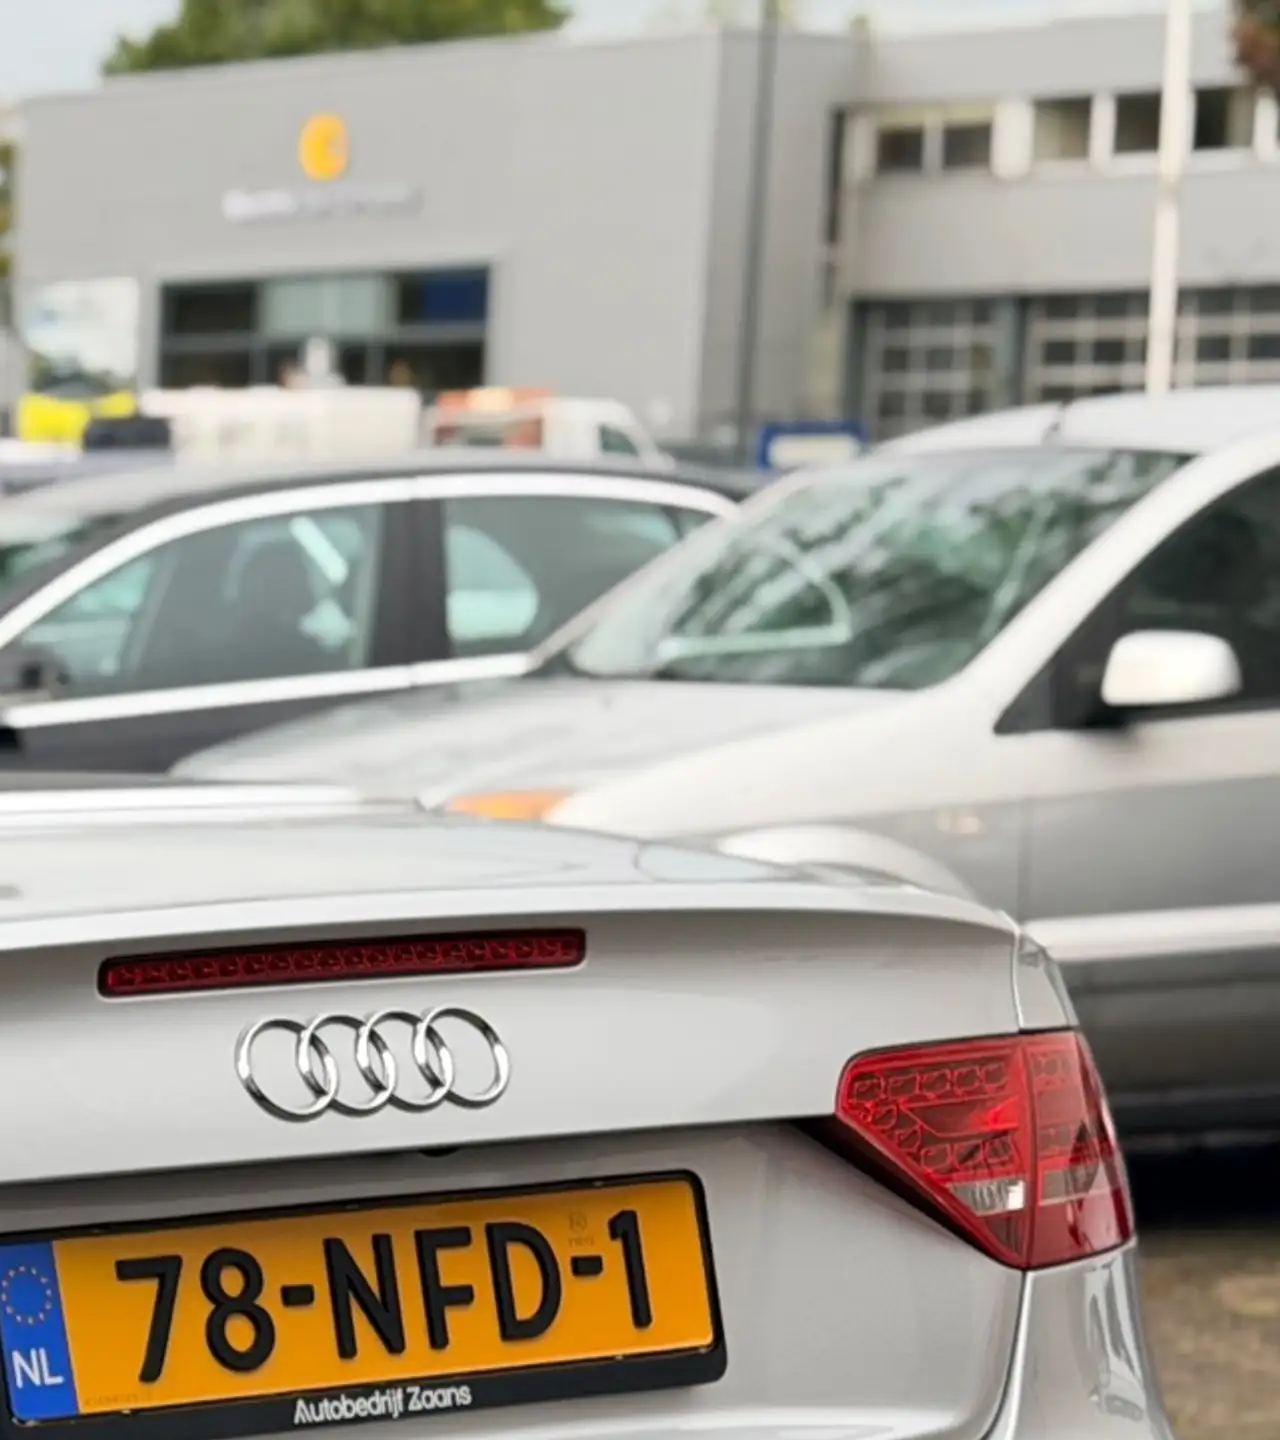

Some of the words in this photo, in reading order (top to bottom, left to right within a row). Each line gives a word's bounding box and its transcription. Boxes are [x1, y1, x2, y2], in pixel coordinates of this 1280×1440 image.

[114, 1209, 653, 1382] 78-NFD-1
[12, 1347, 65, 1389] NL
[293, 1387, 404, 1425] Autobedrijf
[406, 1385, 473, 1412] Zaans
